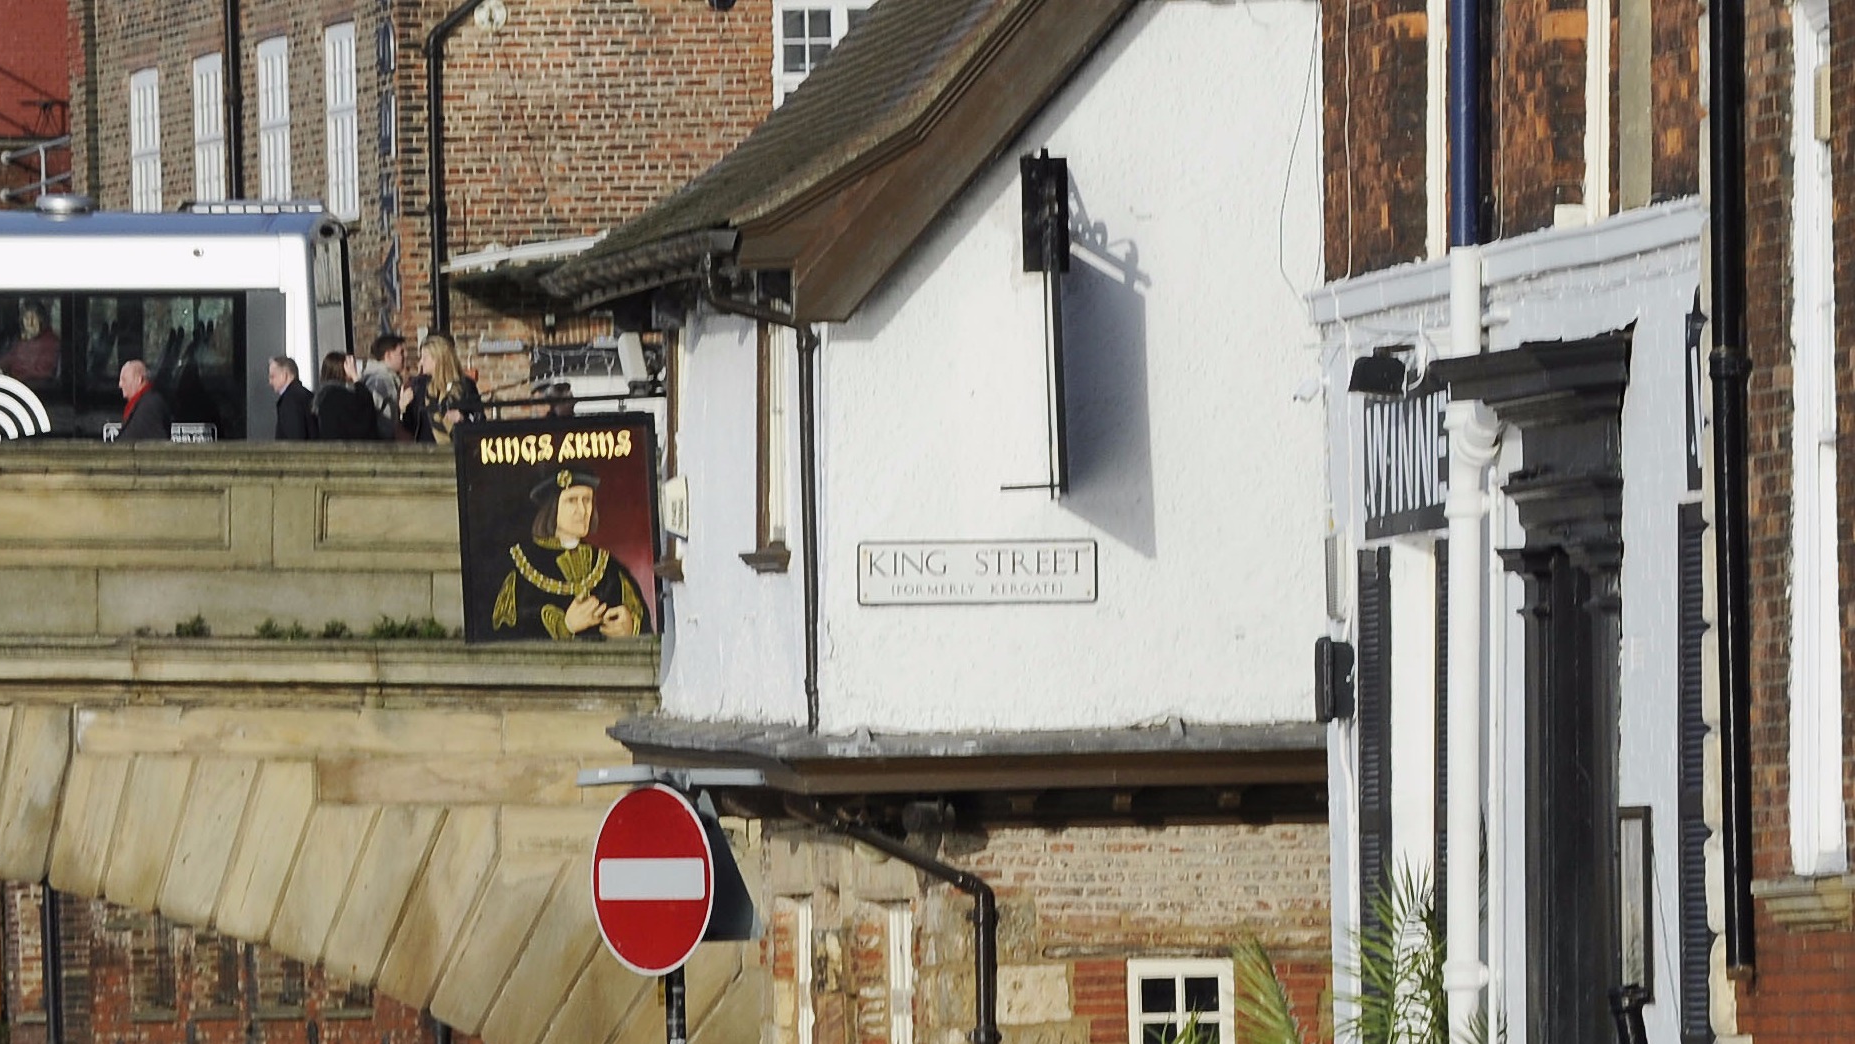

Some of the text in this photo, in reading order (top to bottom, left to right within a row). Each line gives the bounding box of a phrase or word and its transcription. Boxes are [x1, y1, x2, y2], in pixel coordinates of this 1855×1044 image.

[480, 429, 632, 466] KINGS ARMS
[869, 548, 1090, 577] KING STREET
